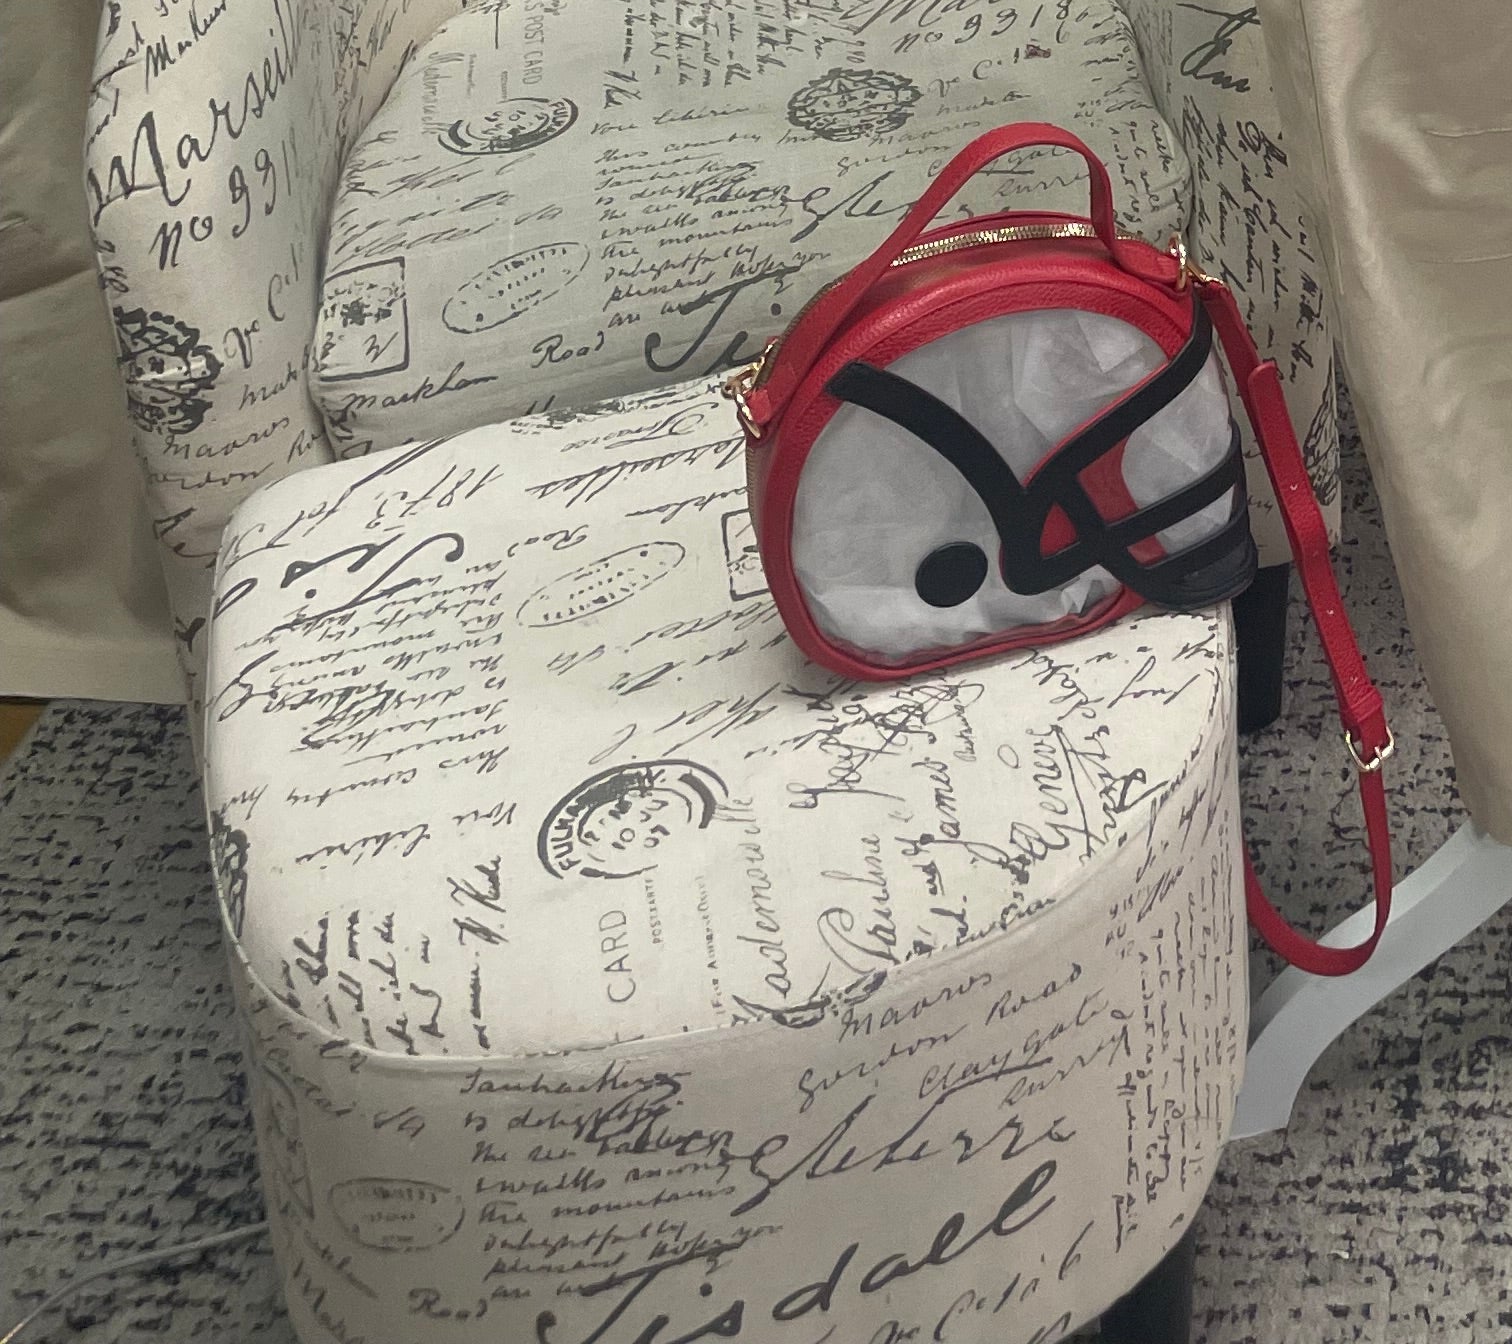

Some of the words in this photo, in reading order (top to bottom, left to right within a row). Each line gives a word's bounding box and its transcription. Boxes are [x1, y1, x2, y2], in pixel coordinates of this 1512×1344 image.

[523, 14, 545, 44] POST
[522, 50, 544, 85] CARD
[523, 436, 746, 505] arseilles
[625, 485, 745, 522] arkham
[597, 908, 637, 1004] CARD
